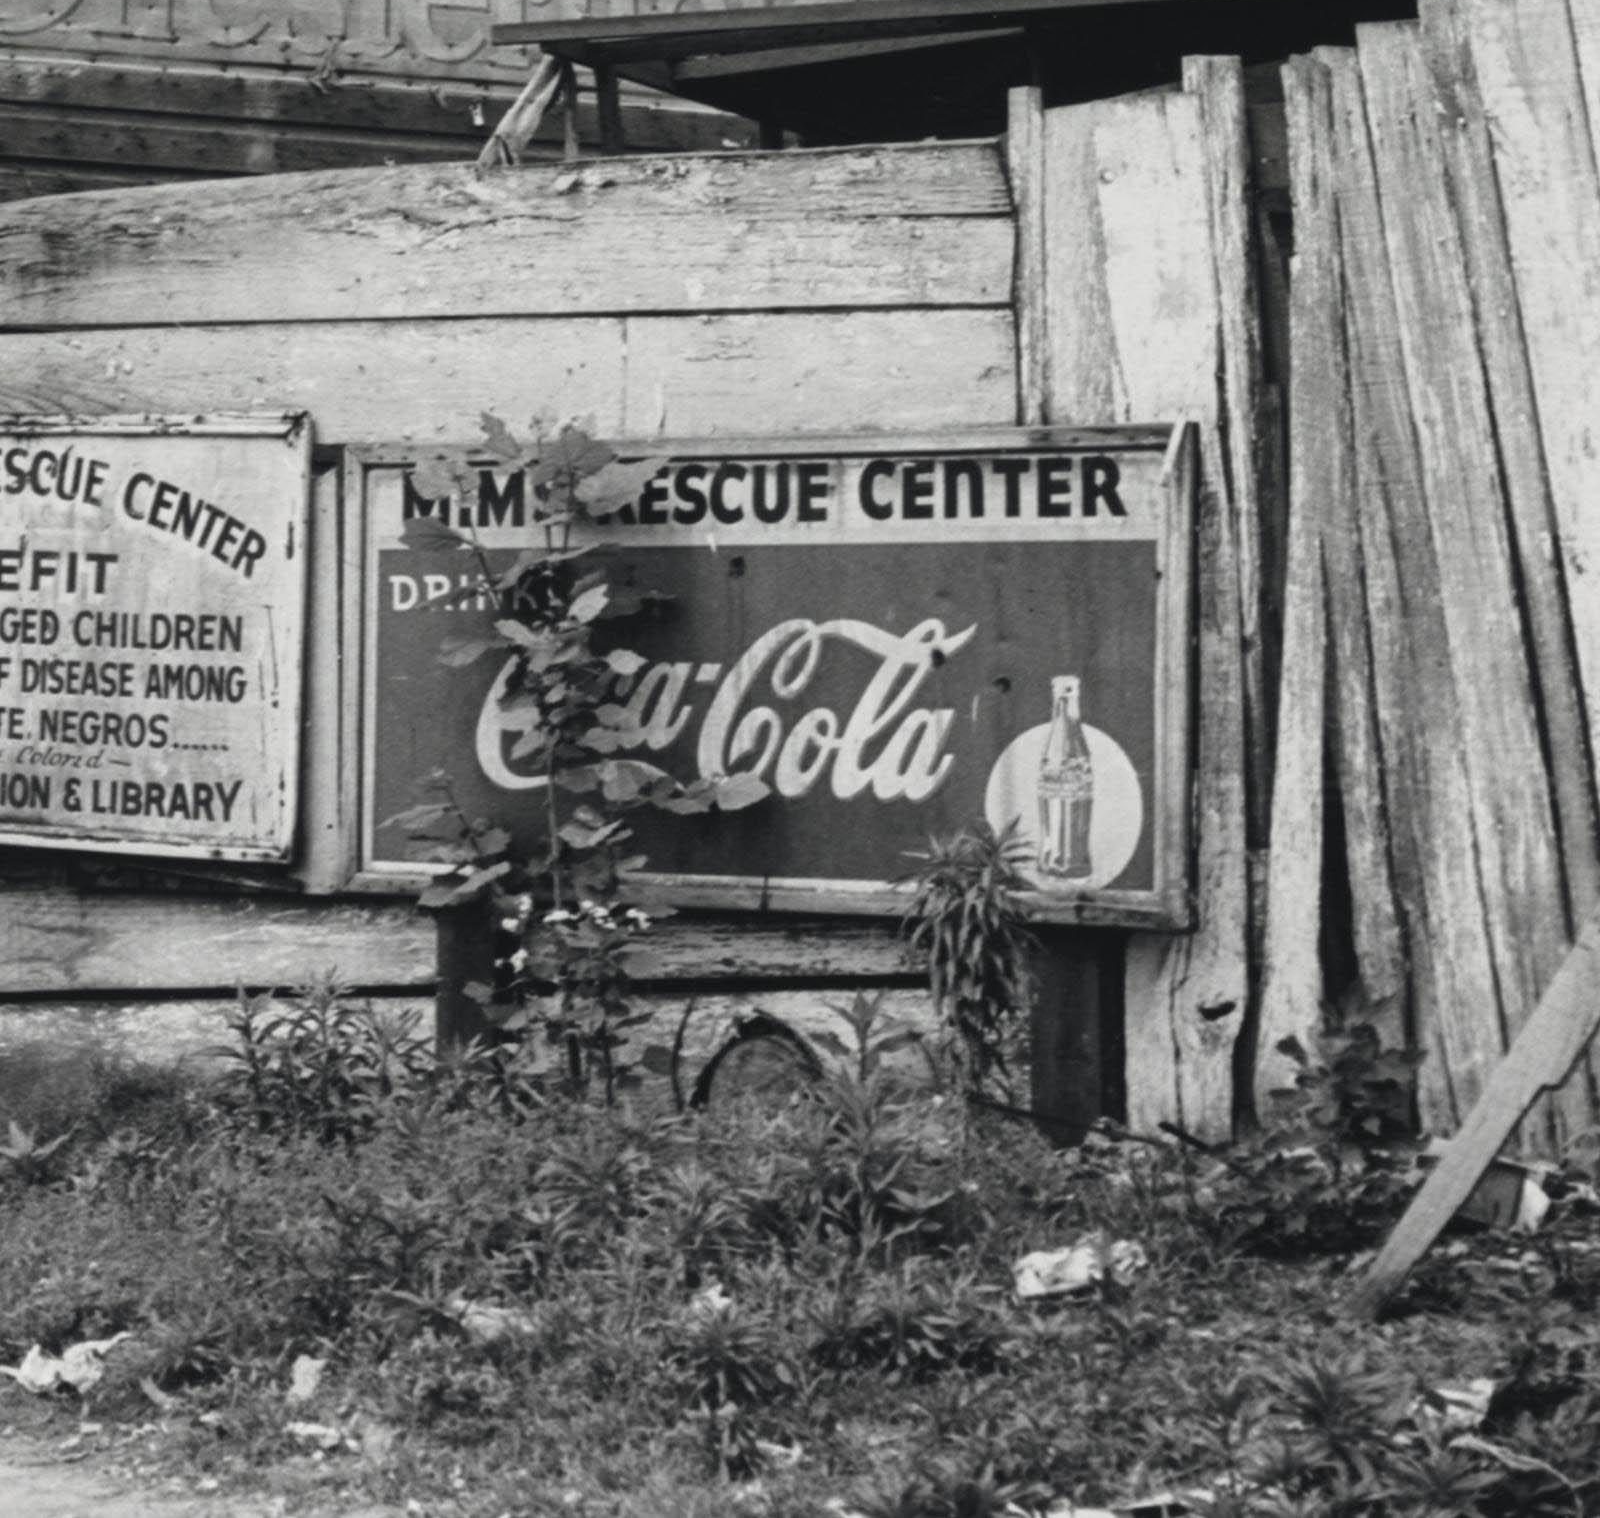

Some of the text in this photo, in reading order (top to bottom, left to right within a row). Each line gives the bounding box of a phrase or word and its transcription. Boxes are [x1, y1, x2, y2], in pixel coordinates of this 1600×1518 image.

[596, 462, 830, 525] ESCUE
[122, 472, 267, 578] CENTER
[72, 610, 244, 653] CHILDREN
[20, 657, 135, 699] DISEASE
[144, 663, 248, 704] AMONG
[62, 776, 80, 812] &
[91, 779, 243, 823] LIBRARY
